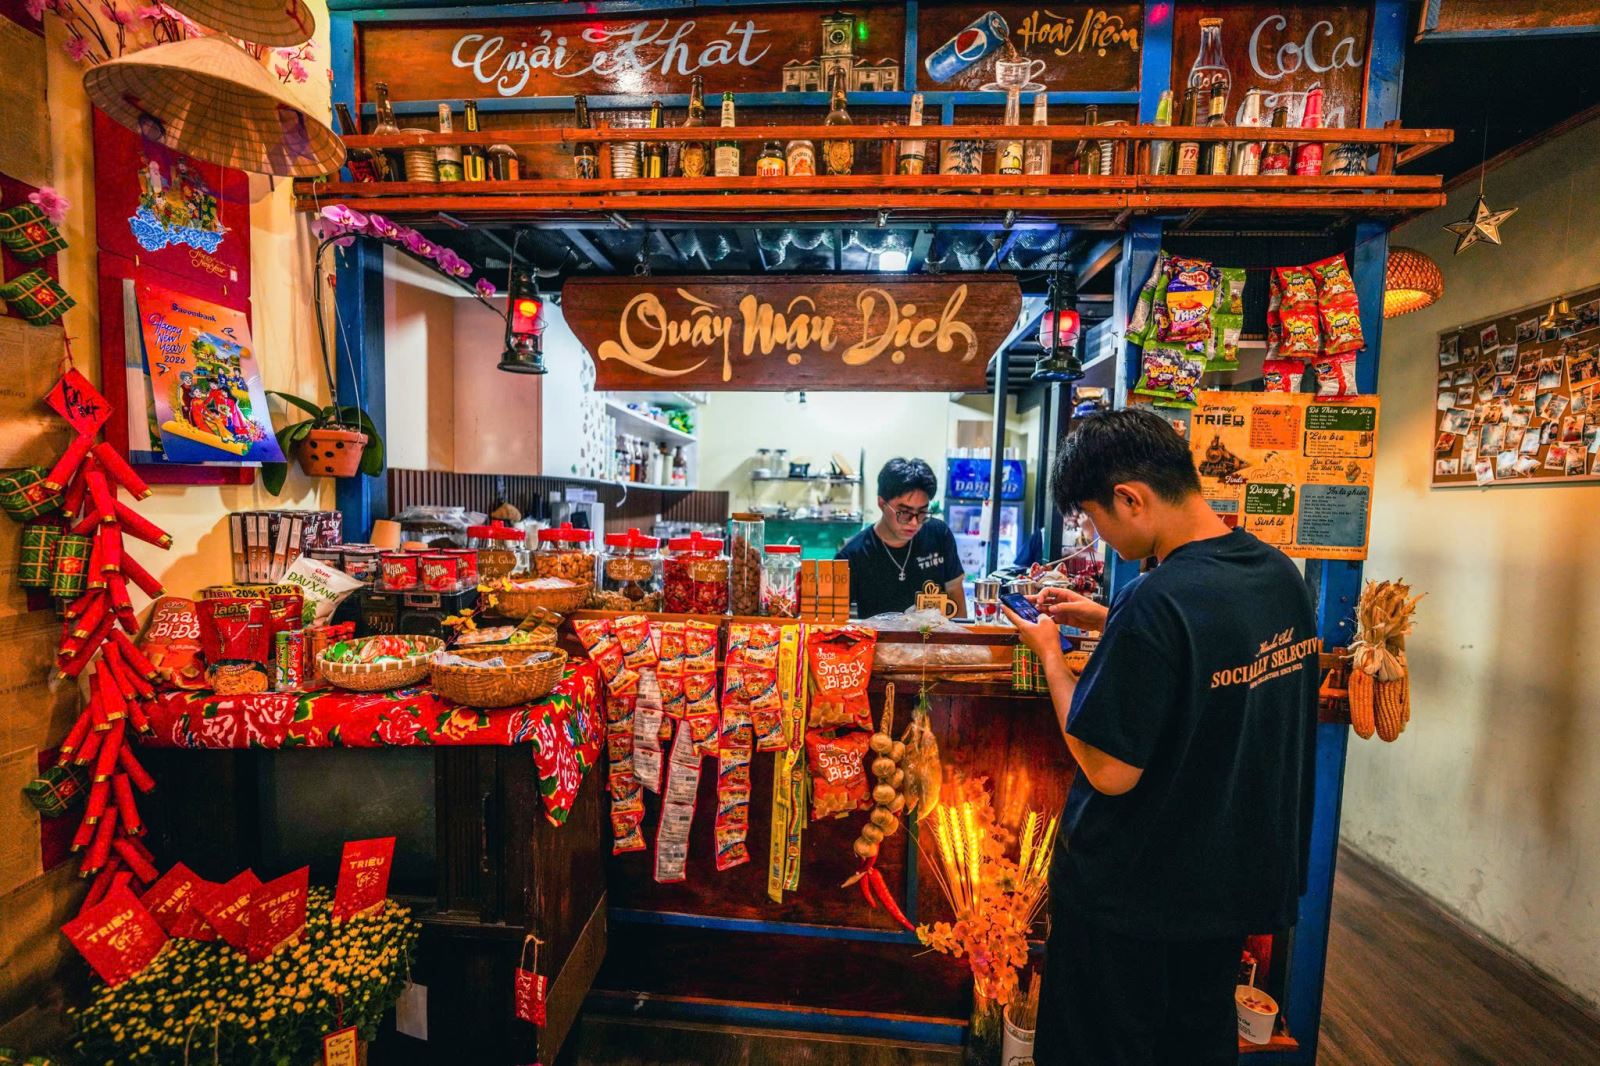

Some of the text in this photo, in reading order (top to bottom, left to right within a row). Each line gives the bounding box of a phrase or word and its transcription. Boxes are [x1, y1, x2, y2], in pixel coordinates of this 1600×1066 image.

[1017, 10, 1072, 52] Hoài
[555, 19, 772, 77] Khát
[1249, 15, 1362, 79] CoCa
[172, 303, 217, 322] Sacombank
[598, 287, 732, 382] Quầy
[842, 284, 979, 366] Dịch
[163, 355, 186, 365] 2026
[308, 580, 340, 602] XANH
[817, 660, 867, 677] Snack
[1211, 655, 1269, 689] SOCIALLY
[818, 749, 863, 768] Snack
